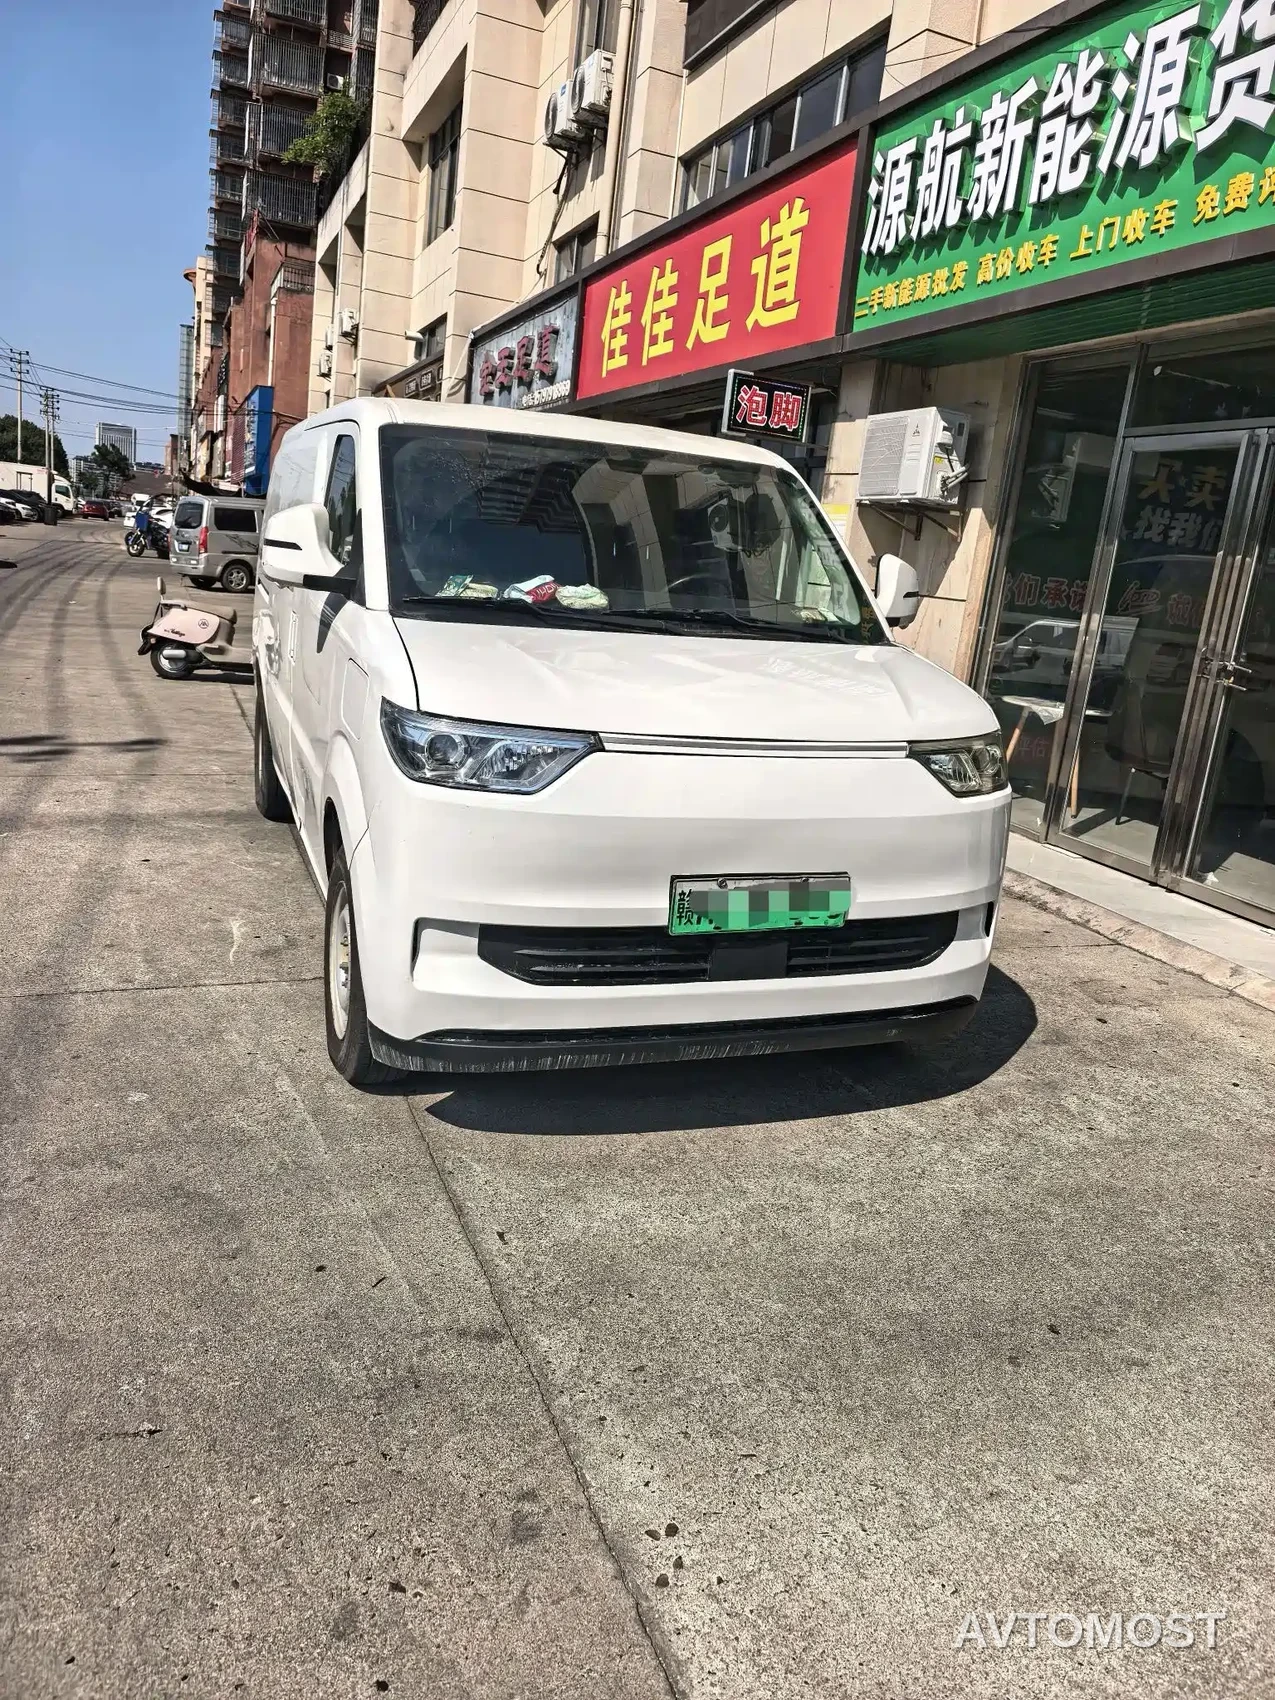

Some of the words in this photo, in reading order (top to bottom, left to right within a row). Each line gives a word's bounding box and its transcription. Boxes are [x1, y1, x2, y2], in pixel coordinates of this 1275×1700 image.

[600, 197, 810, 378] 佳佳足道
[855, 260, 968, 318] 二手新能源批发
[977, 234, 1059, 285] 高价收车
[1069, 199, 1178, 258] 上门收车
[736, 385, 802, 431] 泡脚
